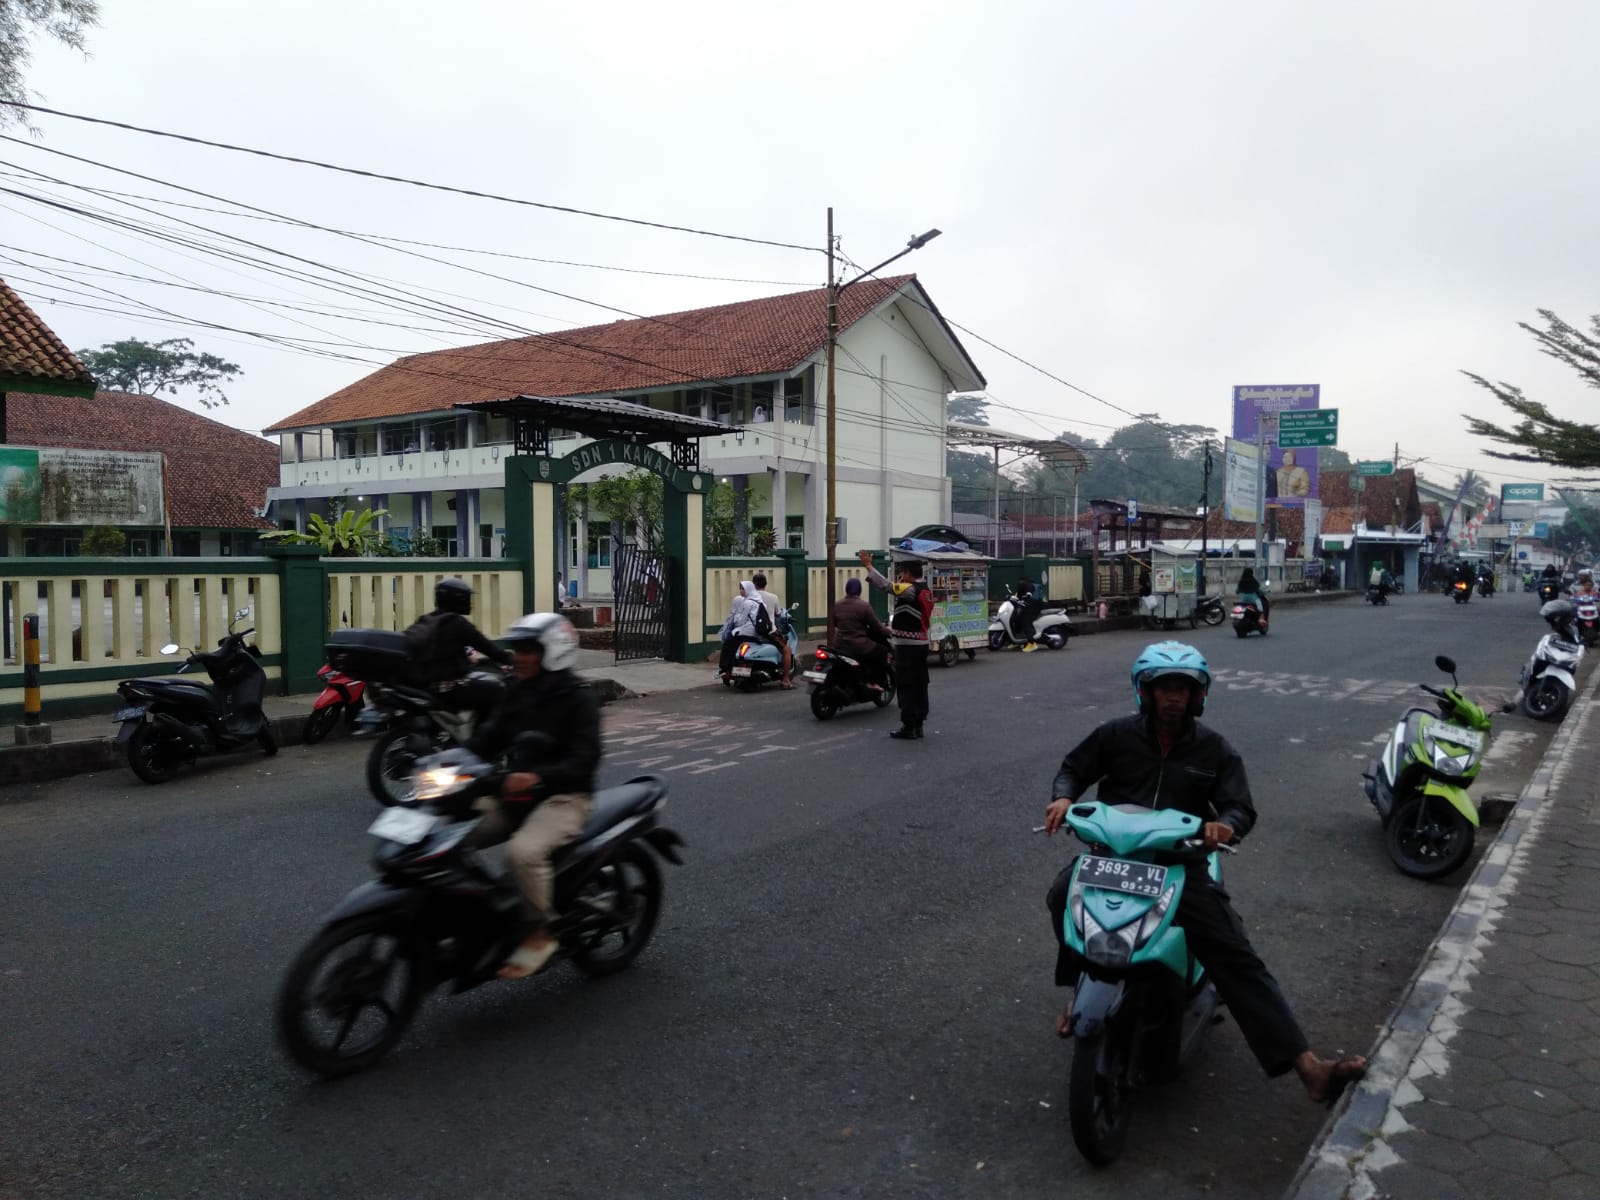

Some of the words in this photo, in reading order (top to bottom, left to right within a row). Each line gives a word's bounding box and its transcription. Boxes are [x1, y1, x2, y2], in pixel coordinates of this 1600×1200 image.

[571, 445, 602, 472] SDN
[608, 444, 615, 459] 1
[623, 443, 678, 482] KAWALI
[1081, 858, 1091, 870] Z
[1097, 860, 1130, 876] 5692
[1147, 867, 1162, 882] VL
